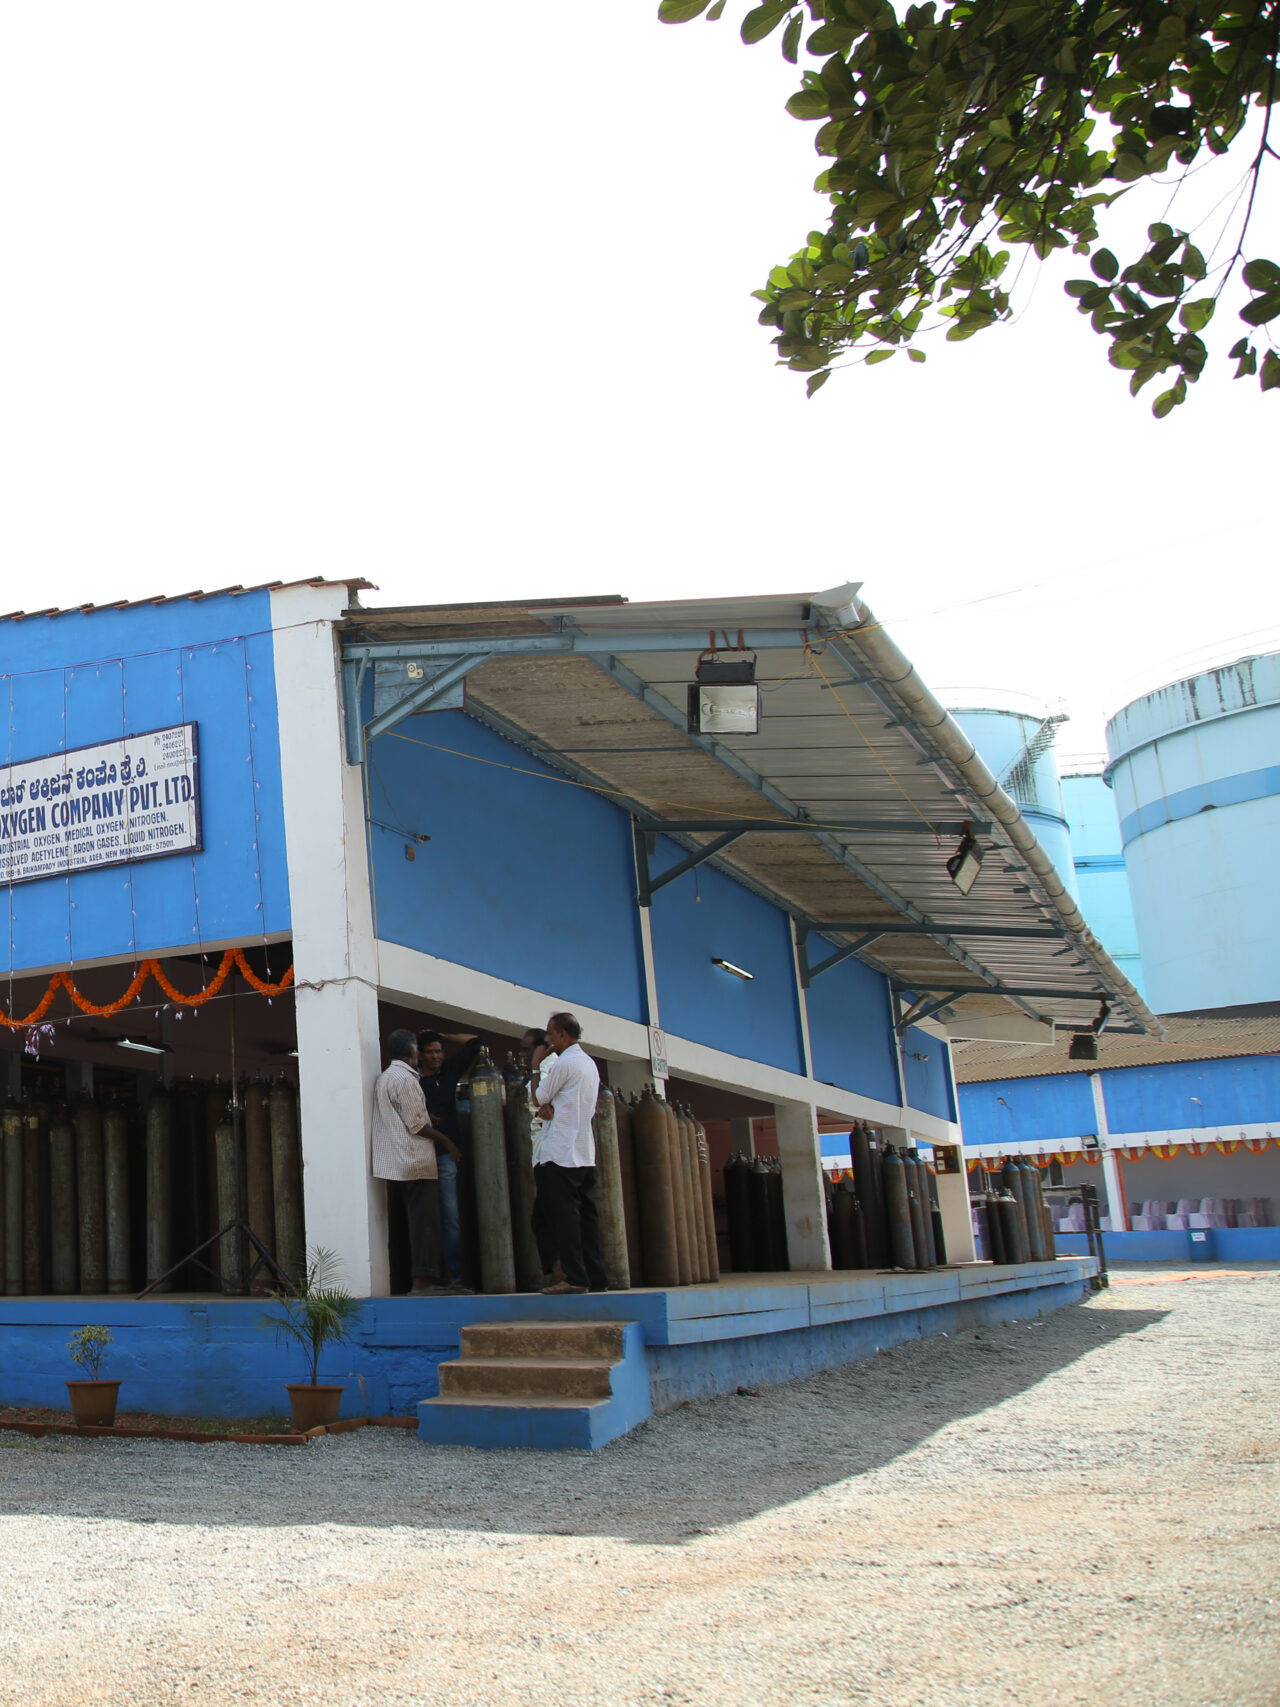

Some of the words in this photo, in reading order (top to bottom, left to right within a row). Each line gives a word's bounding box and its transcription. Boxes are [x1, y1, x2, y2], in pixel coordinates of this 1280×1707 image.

[51, 789, 124, 829] COMPANY
[65, 826, 93, 842] MEDICAL
[73, 841, 95, 854] ARGON
[123, 832, 146, 845] LIQUID
[57, 854, 88, 868] INDUSTRIAL
[105, 850, 118, 859] NEW
